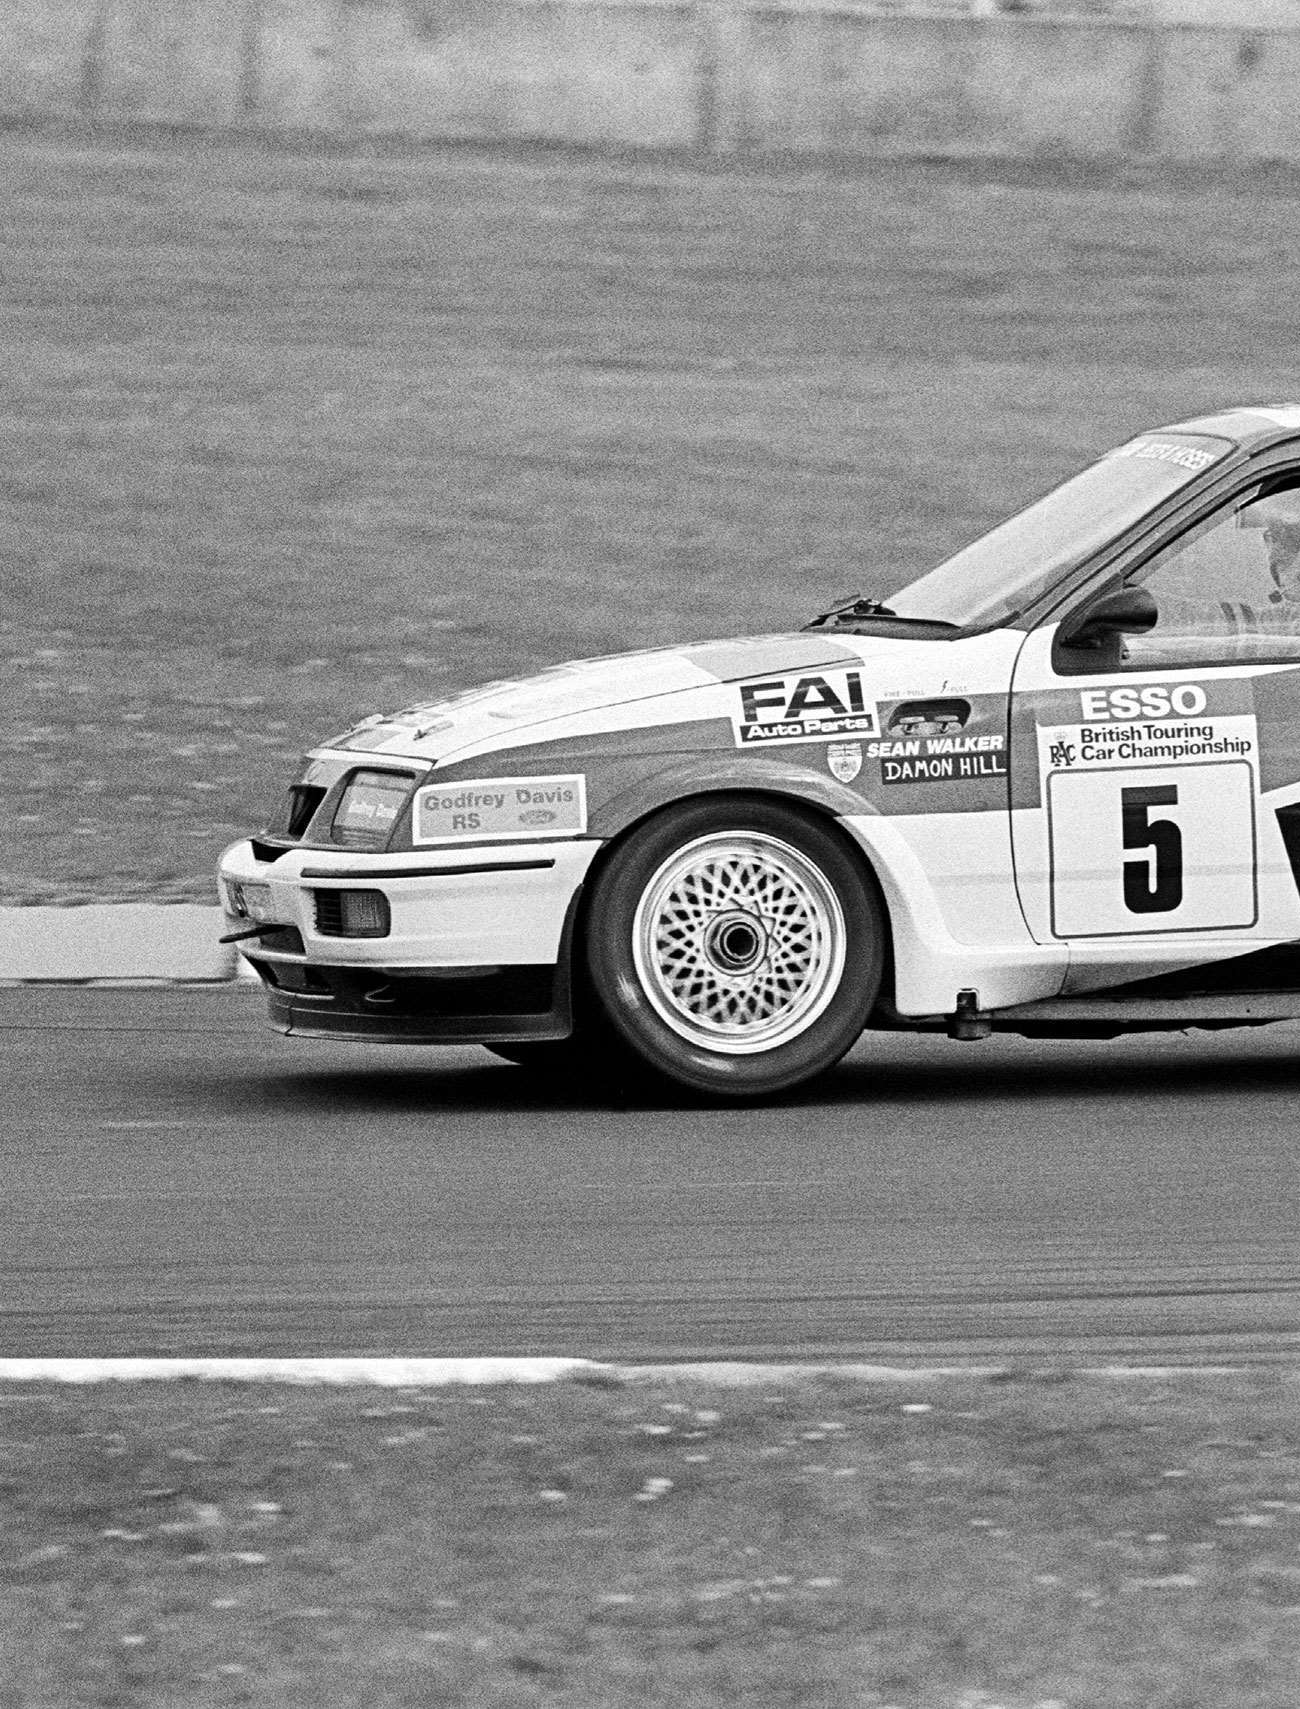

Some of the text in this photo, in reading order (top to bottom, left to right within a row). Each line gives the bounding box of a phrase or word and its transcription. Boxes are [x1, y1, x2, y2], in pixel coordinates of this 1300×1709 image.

[740, 672, 865, 722] FAI
[1081, 685, 1207, 720] ESSO
[747, 717, 868, 739] Auto Parts
[1081, 723, 1213, 744] British Touring
[866, 734, 1004, 758] SEAN WALKER
[1081, 737, 1252, 760] Car Championship
[884, 754, 1007, 780] DAMON HILL
[423, 787, 574, 812] Godfrey Davis
[451, 813, 482, 830] RS
[1121, 784, 1183, 914] 5
